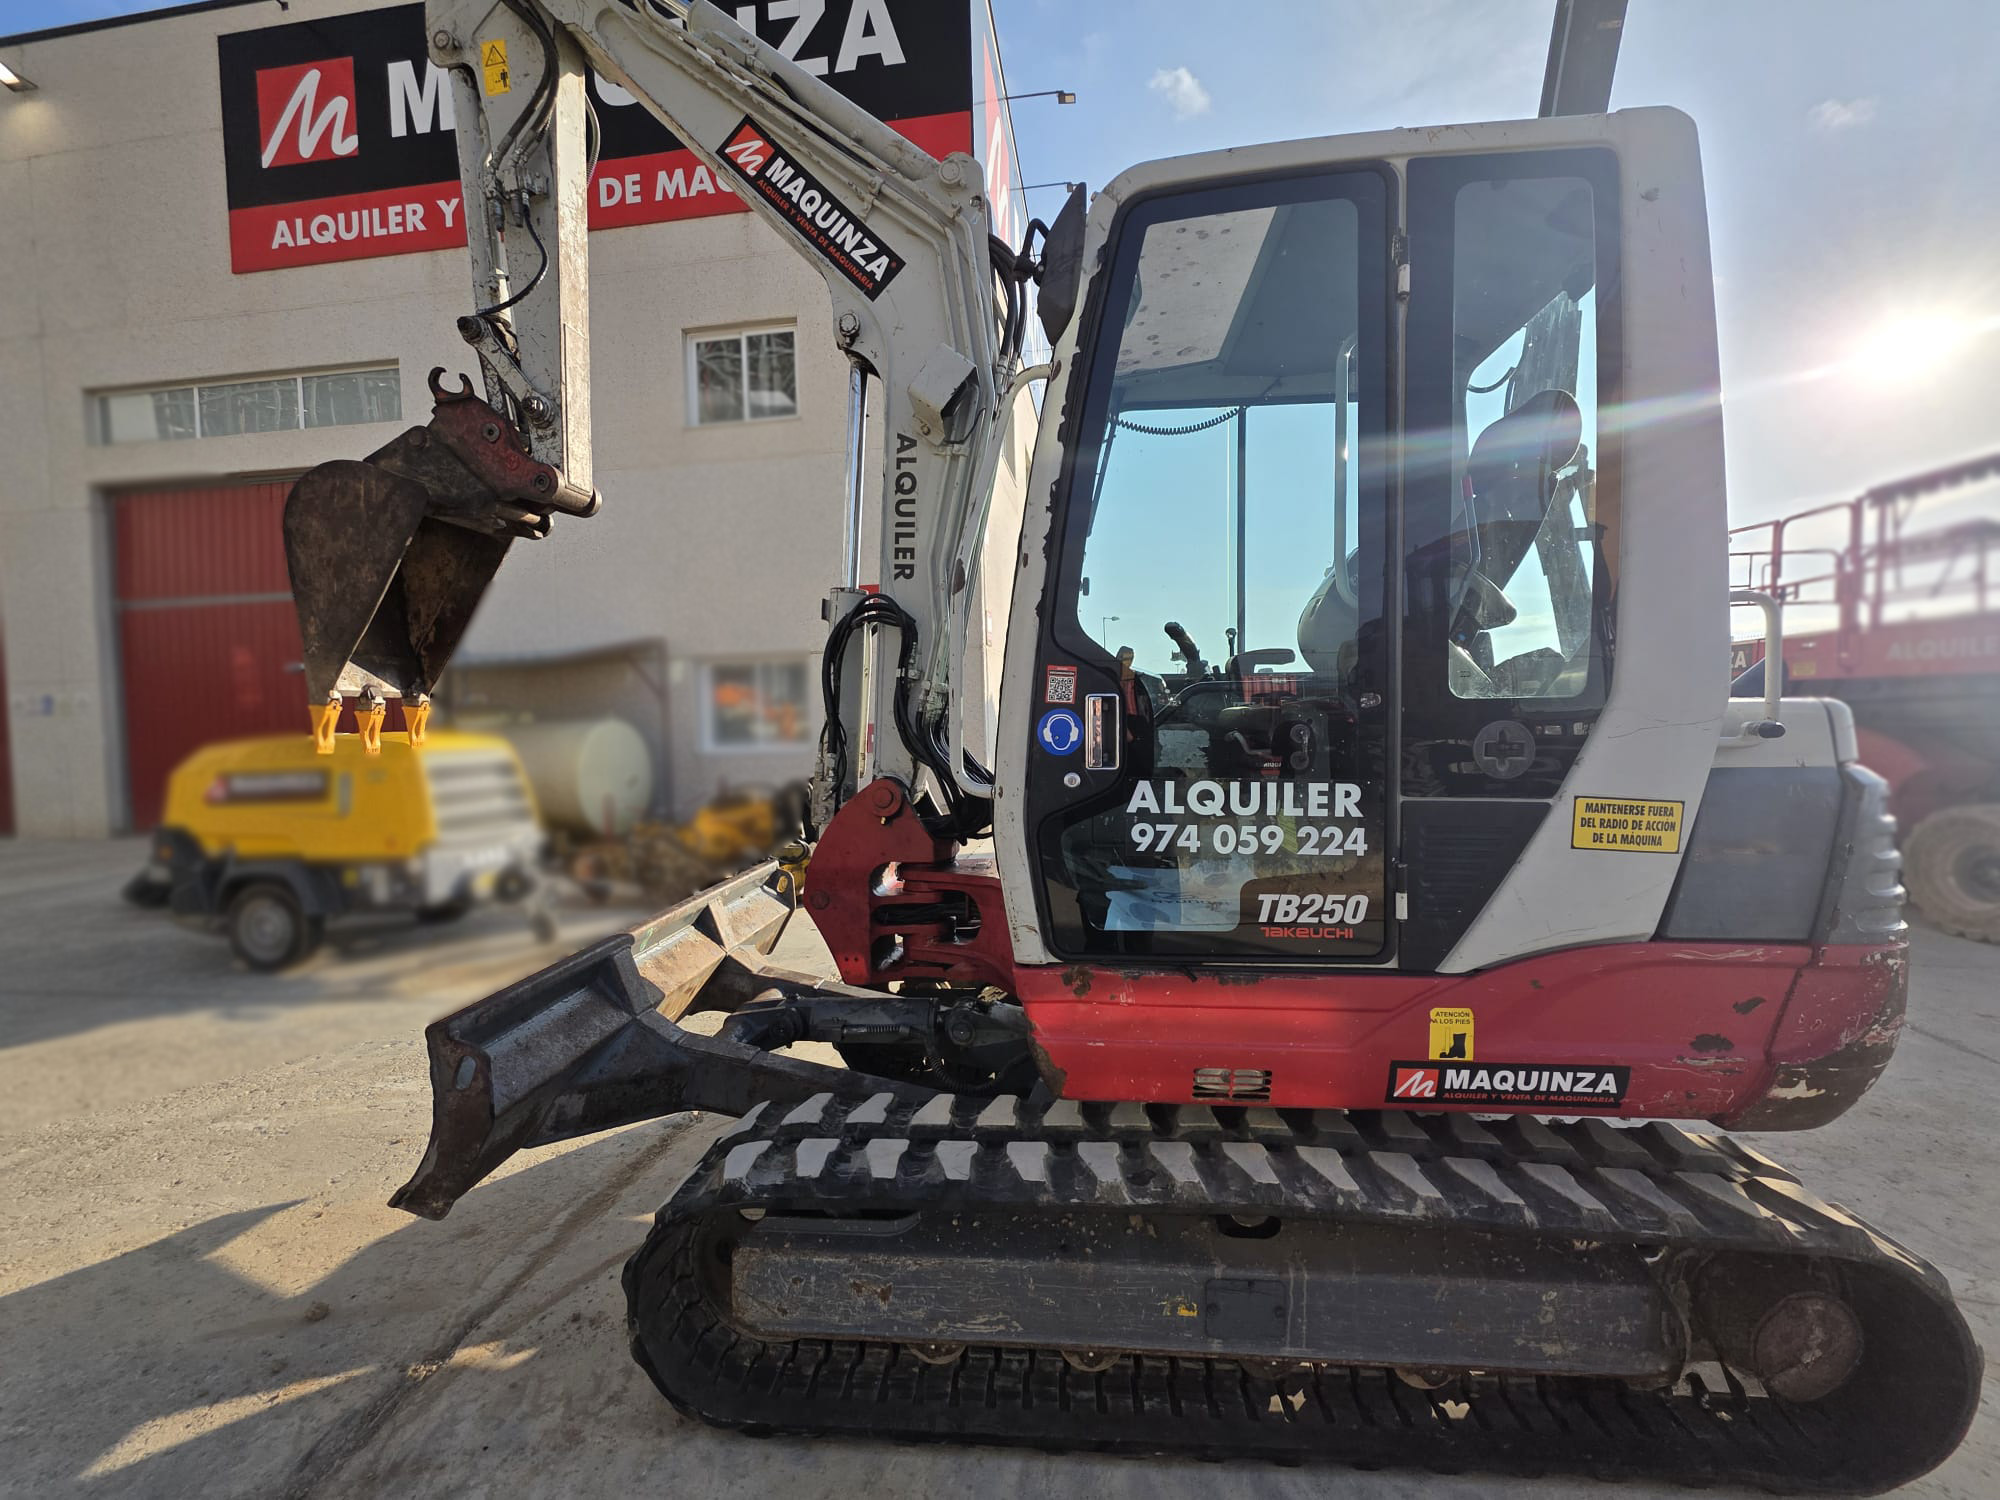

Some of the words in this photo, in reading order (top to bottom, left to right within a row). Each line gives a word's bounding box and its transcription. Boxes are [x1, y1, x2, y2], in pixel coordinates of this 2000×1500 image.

[271, 202, 427, 250] ALQUILER
[435, 198, 461, 228] Y
[598, 173, 643, 208] DE
[764, 156, 891, 282] MAQUINZA
[756, 179, 790, 211] ALQUILER
[796, 214, 819, 239] VENTA
[817, 234, 829, 249] DE
[828, 245, 874, 290] MAQUINARIA
[893, 432, 918, 581] ALQUILER
[1126, 780, 1365, 818] ALQUILER
[1584, 802, 1646, 817] MANTENERSE
[1647, 805, 1675, 818] FUERA
[1130, 822, 1201, 853] 974
[1212, 824, 1285, 855] 059
[1296, 825, 1369, 857] 224
[1580, 816, 1597, 829] DEL
[1599, 818, 1629, 830] RADIO
[1631, 819, 1643, 831] DE
[1645, 818, 1677, 832] ACCIÓN
[1592, 832, 1605, 844] DE
[1606, 833, 1618, 845] LA
[1620, 831, 1663, 847] MÁQUINA
[1257, 893, 1370, 925] TB250
[1444, 1068, 1618, 1094] MAQUINZA
[1500, 1093, 1531, 1101] VENTA
[1549, 1095, 1615, 1104] MAQUINARIA
